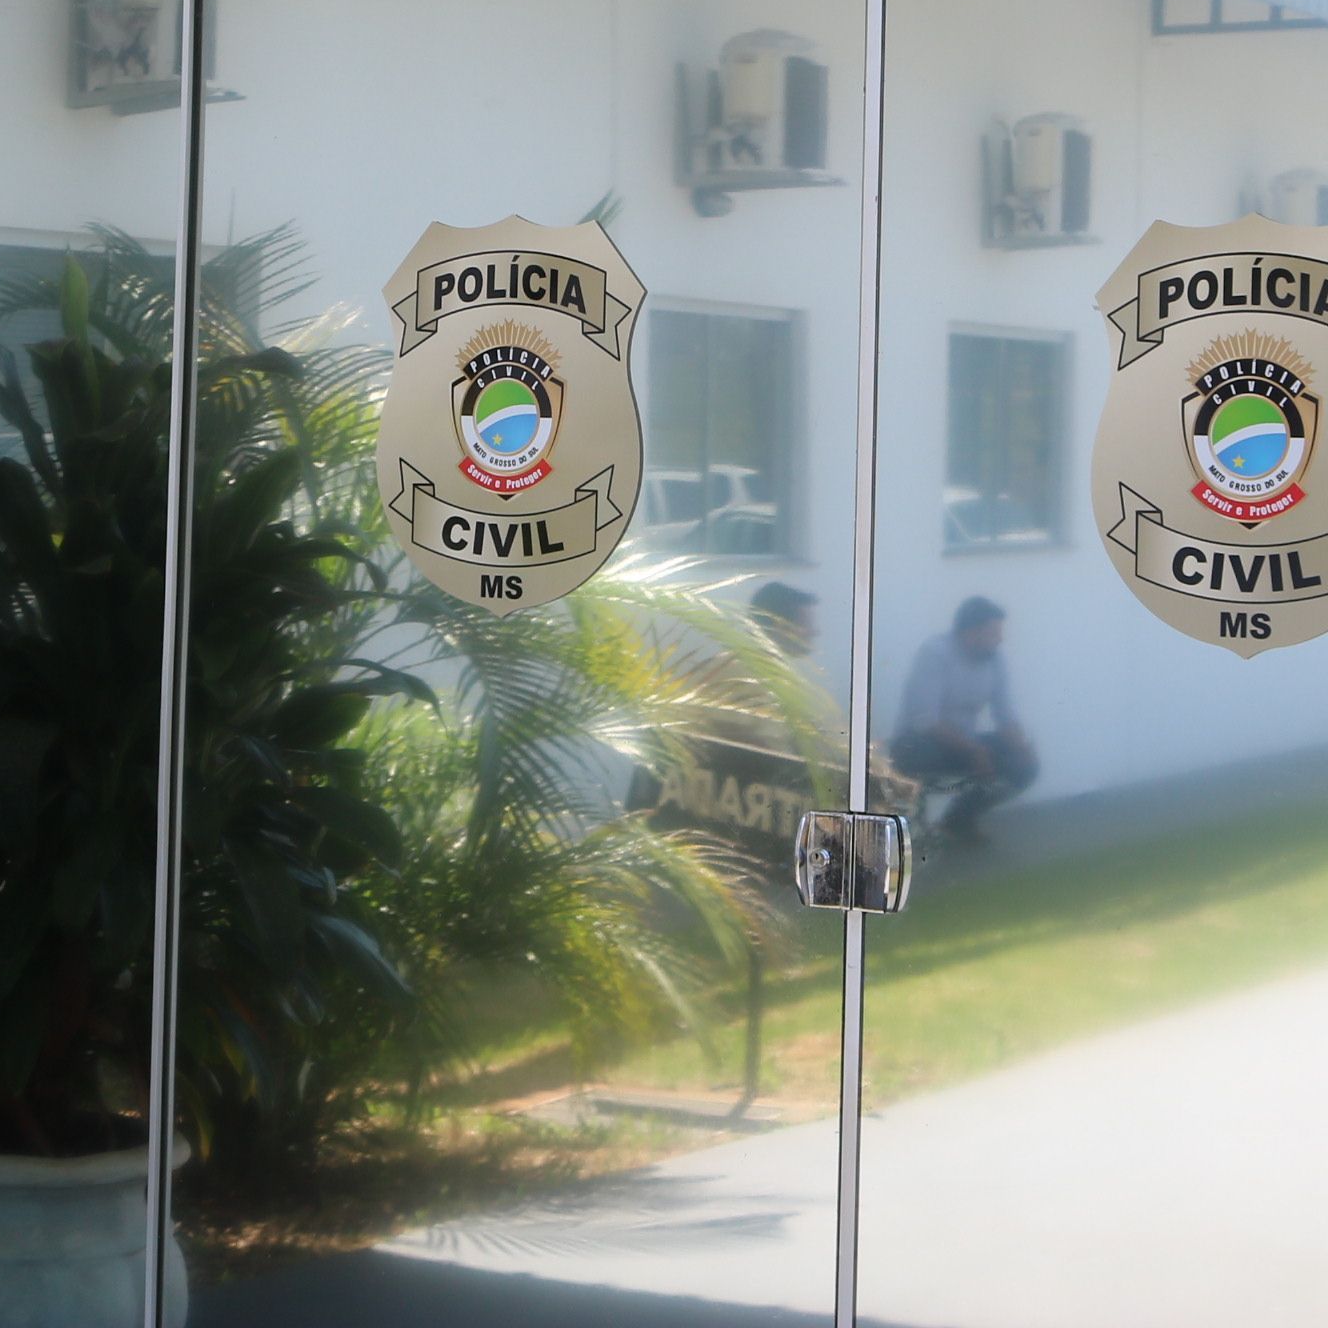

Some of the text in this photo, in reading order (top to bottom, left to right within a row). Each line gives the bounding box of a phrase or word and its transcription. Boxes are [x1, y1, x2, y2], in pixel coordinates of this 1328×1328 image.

[433, 255, 586, 314] POLÍCIA
[470, 346, 550, 378] POLÍCIA
[477, 366, 538, 390] CIVIL
[1204, 359, 1302, 393] POLÍCIA
[1213, 381, 1287, 407] CIVIL
[489, 457, 517, 467] GROSSO
[519, 455, 527, 464] DO
[467, 464, 542, 489] Servir e Proteger
[1229, 481, 1262, 492] GROSSO
[1264, 479, 1275, 489] DO
[1202, 489, 1293, 516] Servir e Proteger
[441, 516, 564, 558] CIVIL
[1172, 546, 1322, 593] CIVIL
[480, 575, 523, 600] MS
[1219, 612, 1272, 640] MS
